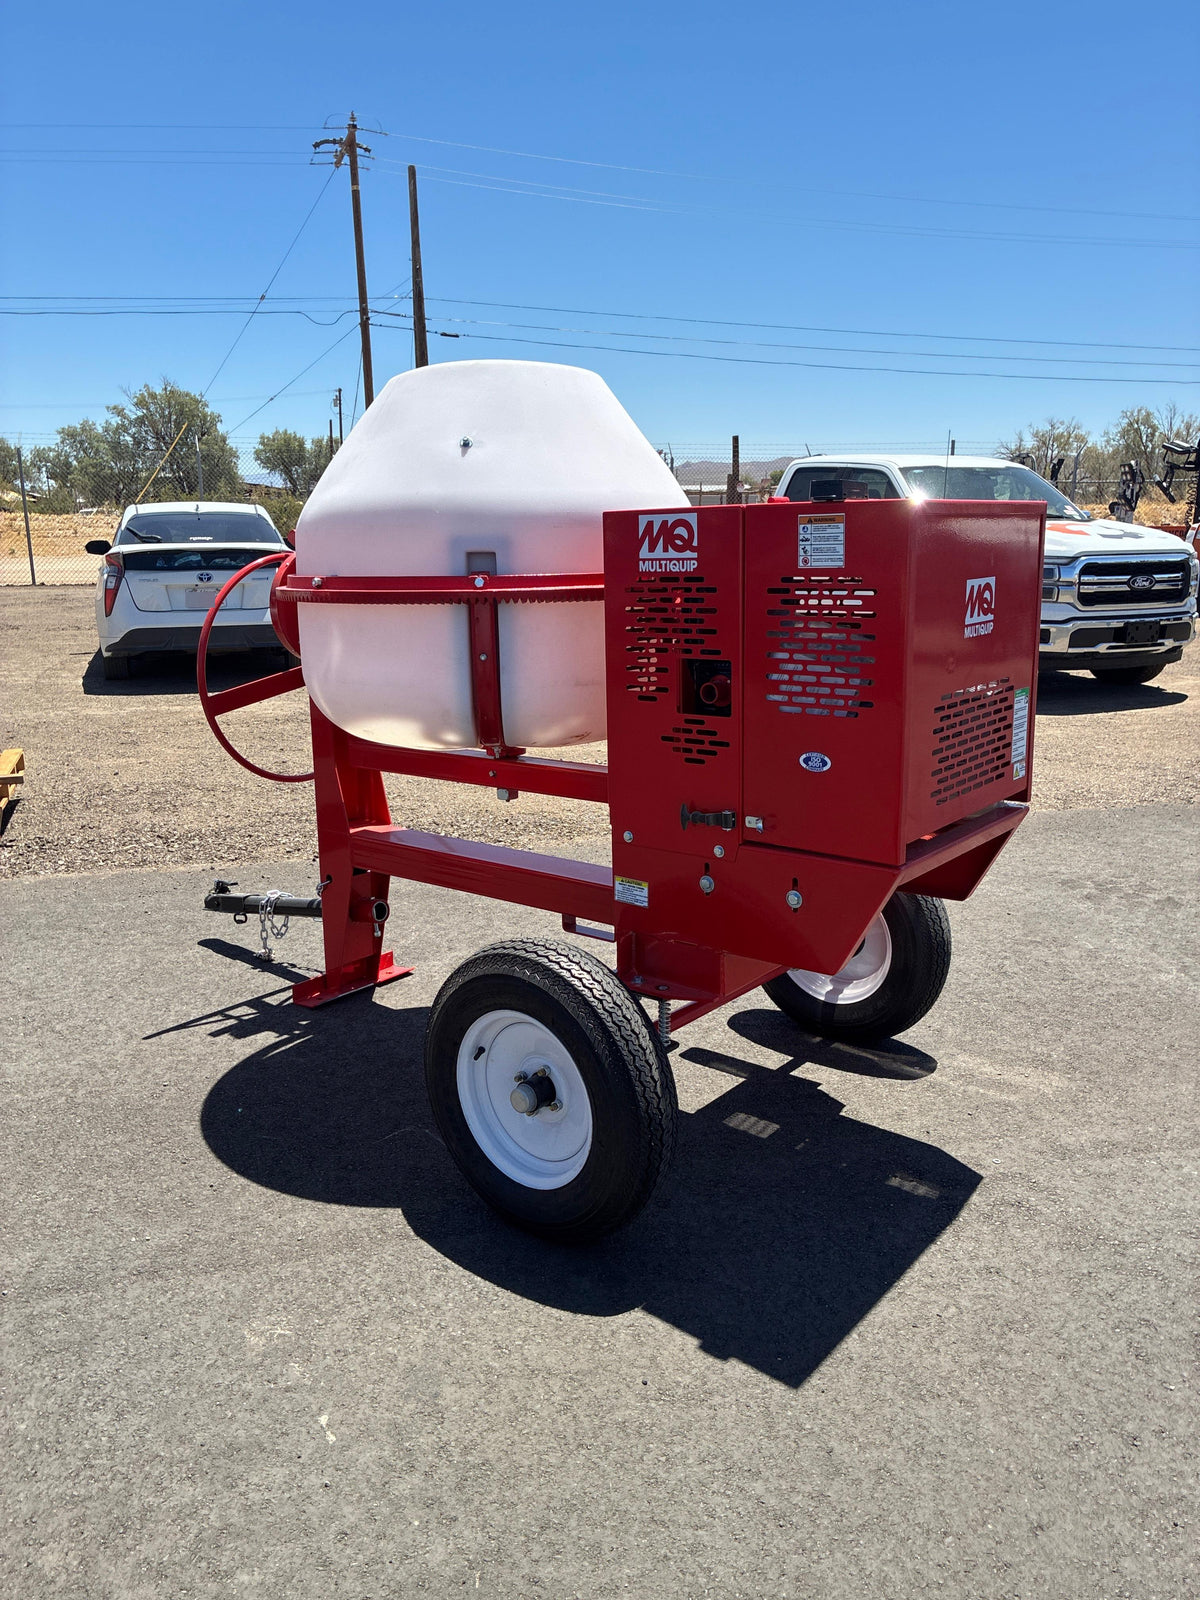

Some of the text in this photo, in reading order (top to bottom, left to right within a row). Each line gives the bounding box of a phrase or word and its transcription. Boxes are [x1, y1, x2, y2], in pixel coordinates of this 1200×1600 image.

[639, 517, 697, 553] MQ
[639, 560, 698, 572] MULTIQUIP
[1134, 577, 1150, 587] Ford
[965, 582, 994, 618] MQ
[964, 622, 994, 639] MULTIQUIP
